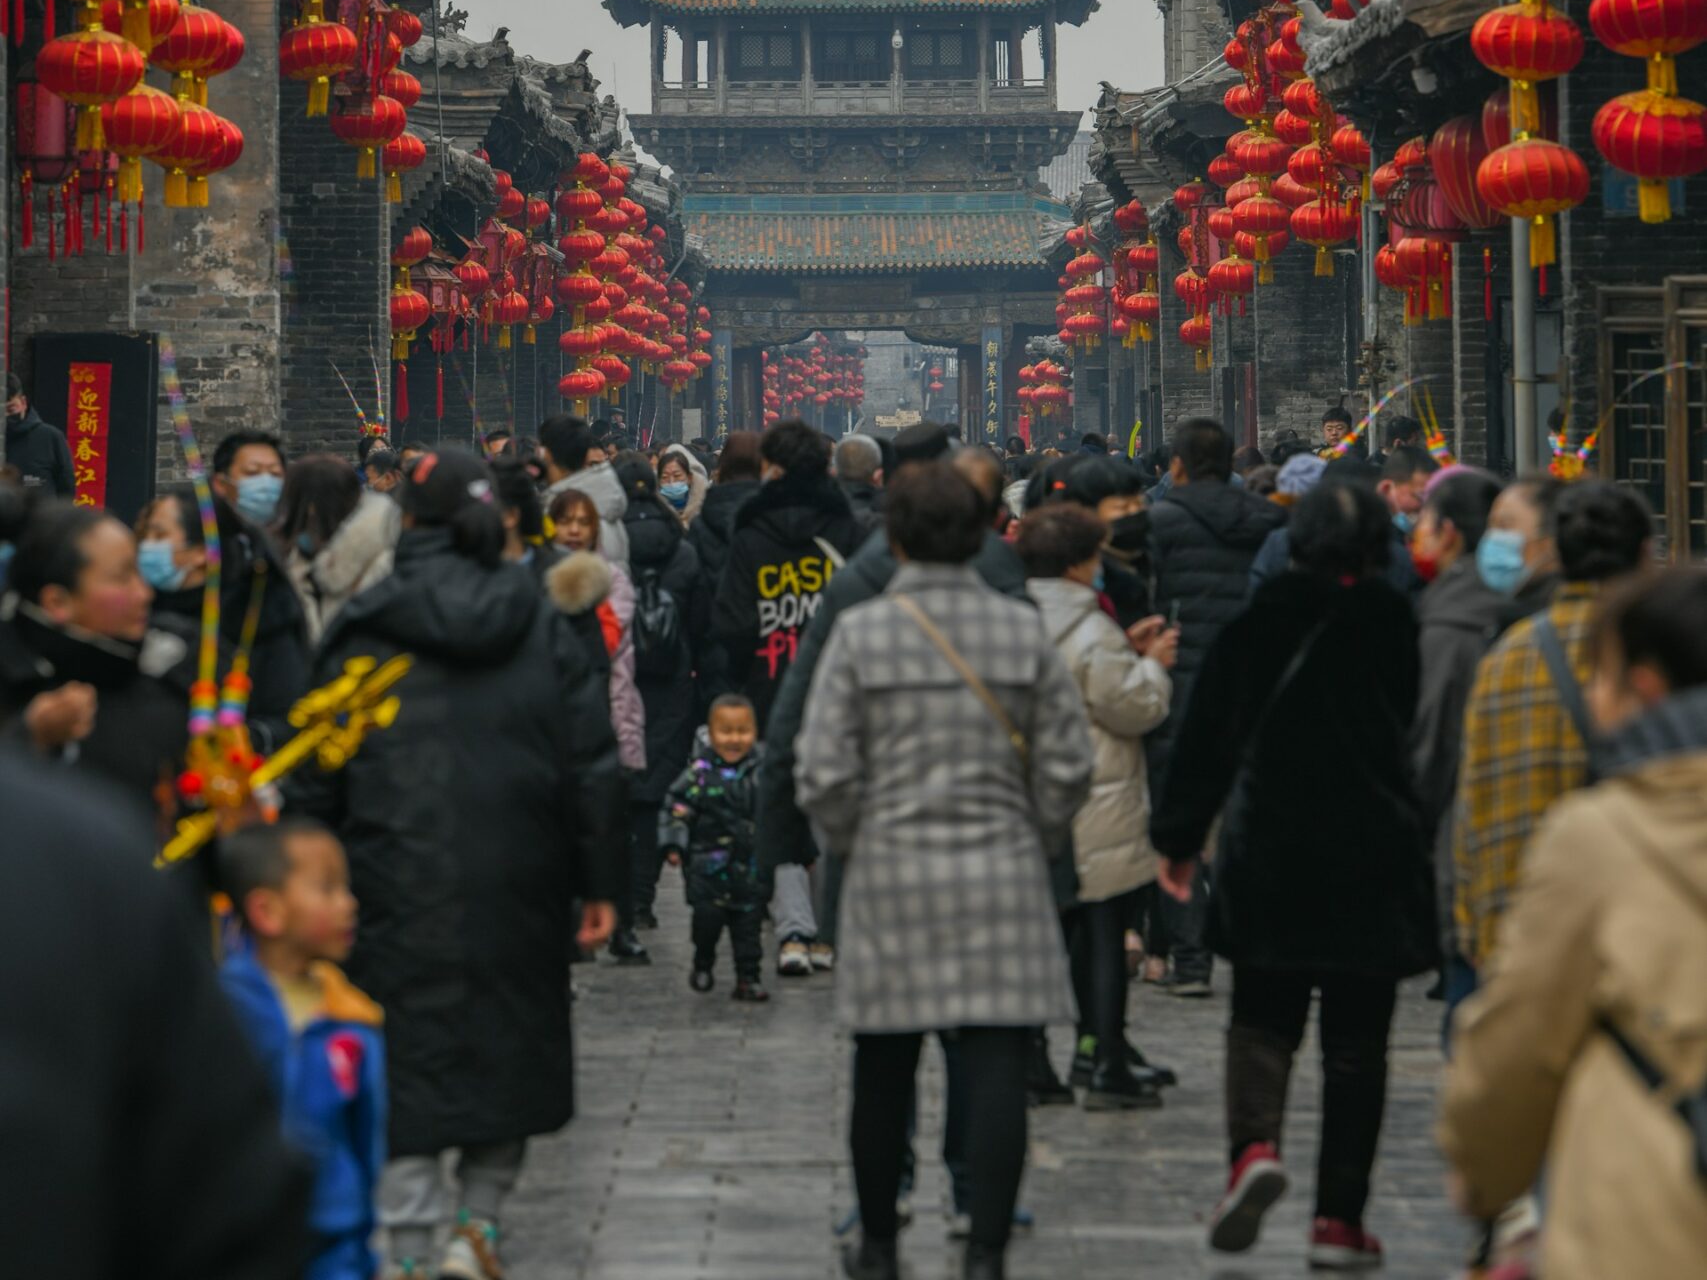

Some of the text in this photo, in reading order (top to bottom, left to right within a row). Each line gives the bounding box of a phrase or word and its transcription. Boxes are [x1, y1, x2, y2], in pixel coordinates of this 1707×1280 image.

[73, 387, 101, 506] 迎新春江山
